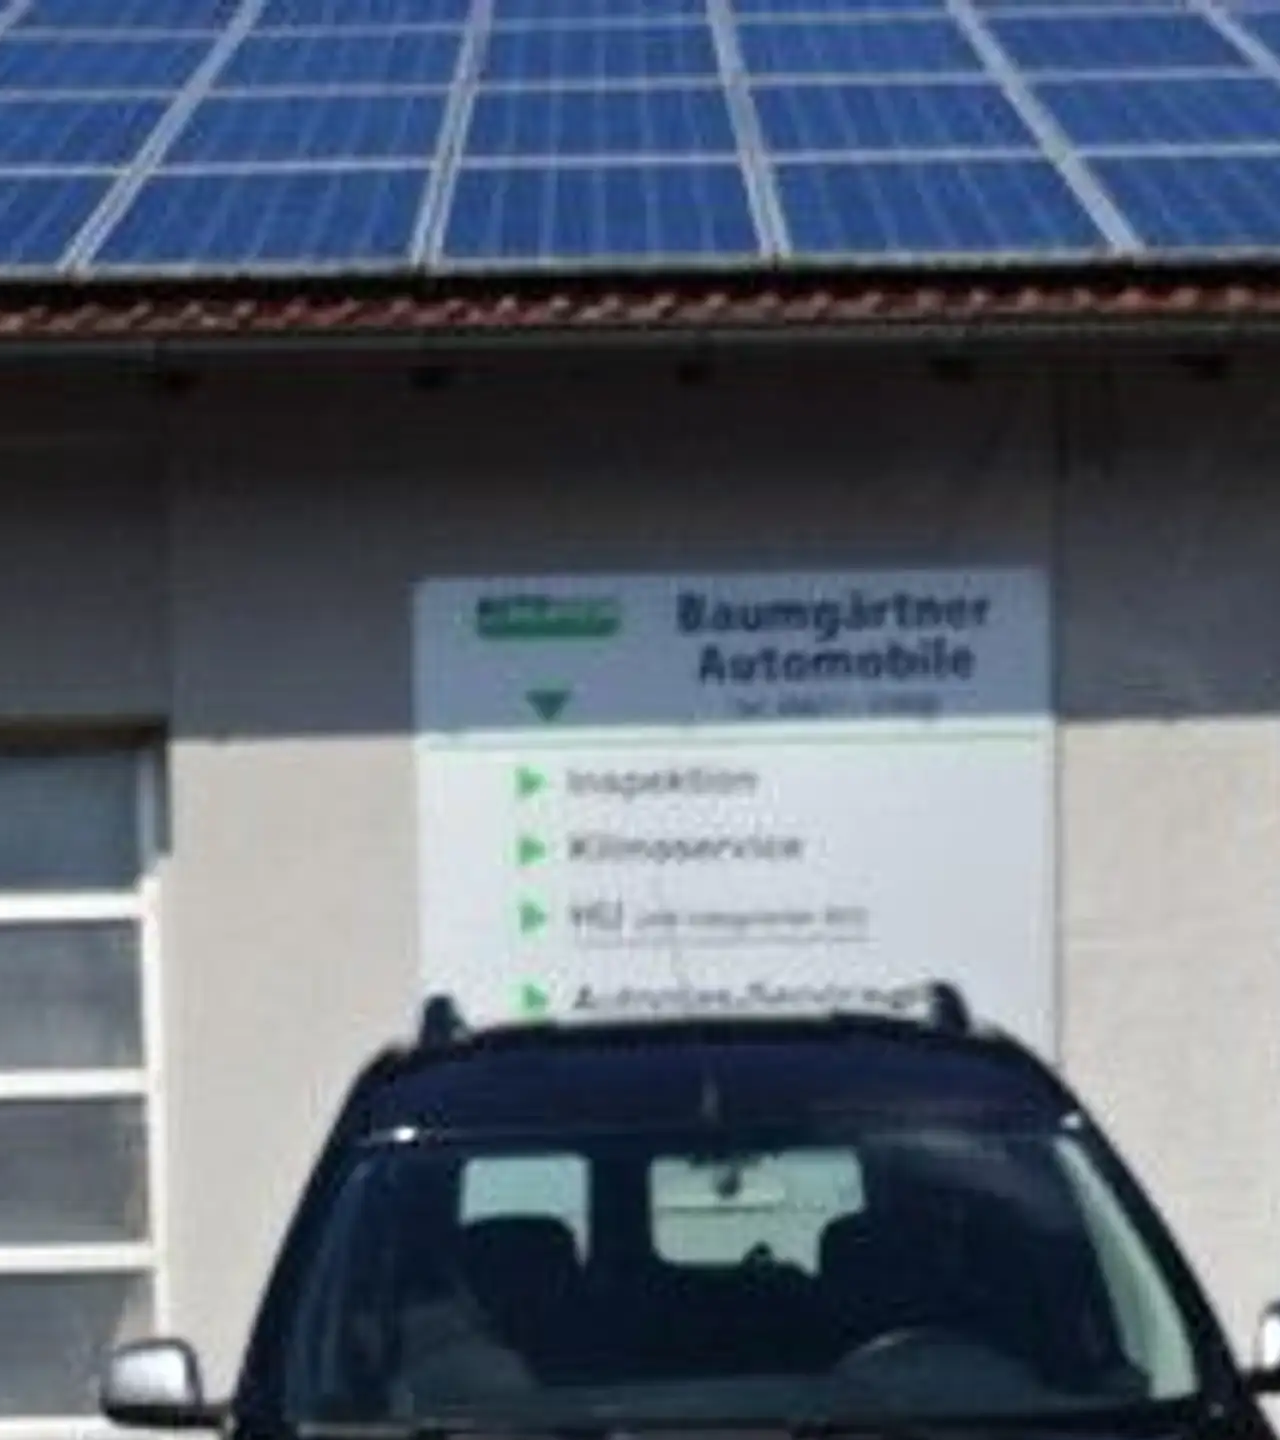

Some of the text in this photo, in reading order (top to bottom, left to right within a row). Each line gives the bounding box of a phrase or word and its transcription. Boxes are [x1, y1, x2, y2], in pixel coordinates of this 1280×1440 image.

[675, 590, 991, 643] Baumgärtner
[699, 637, 977, 686] Automobile
[568, 767, 759, 801] Inspektion
